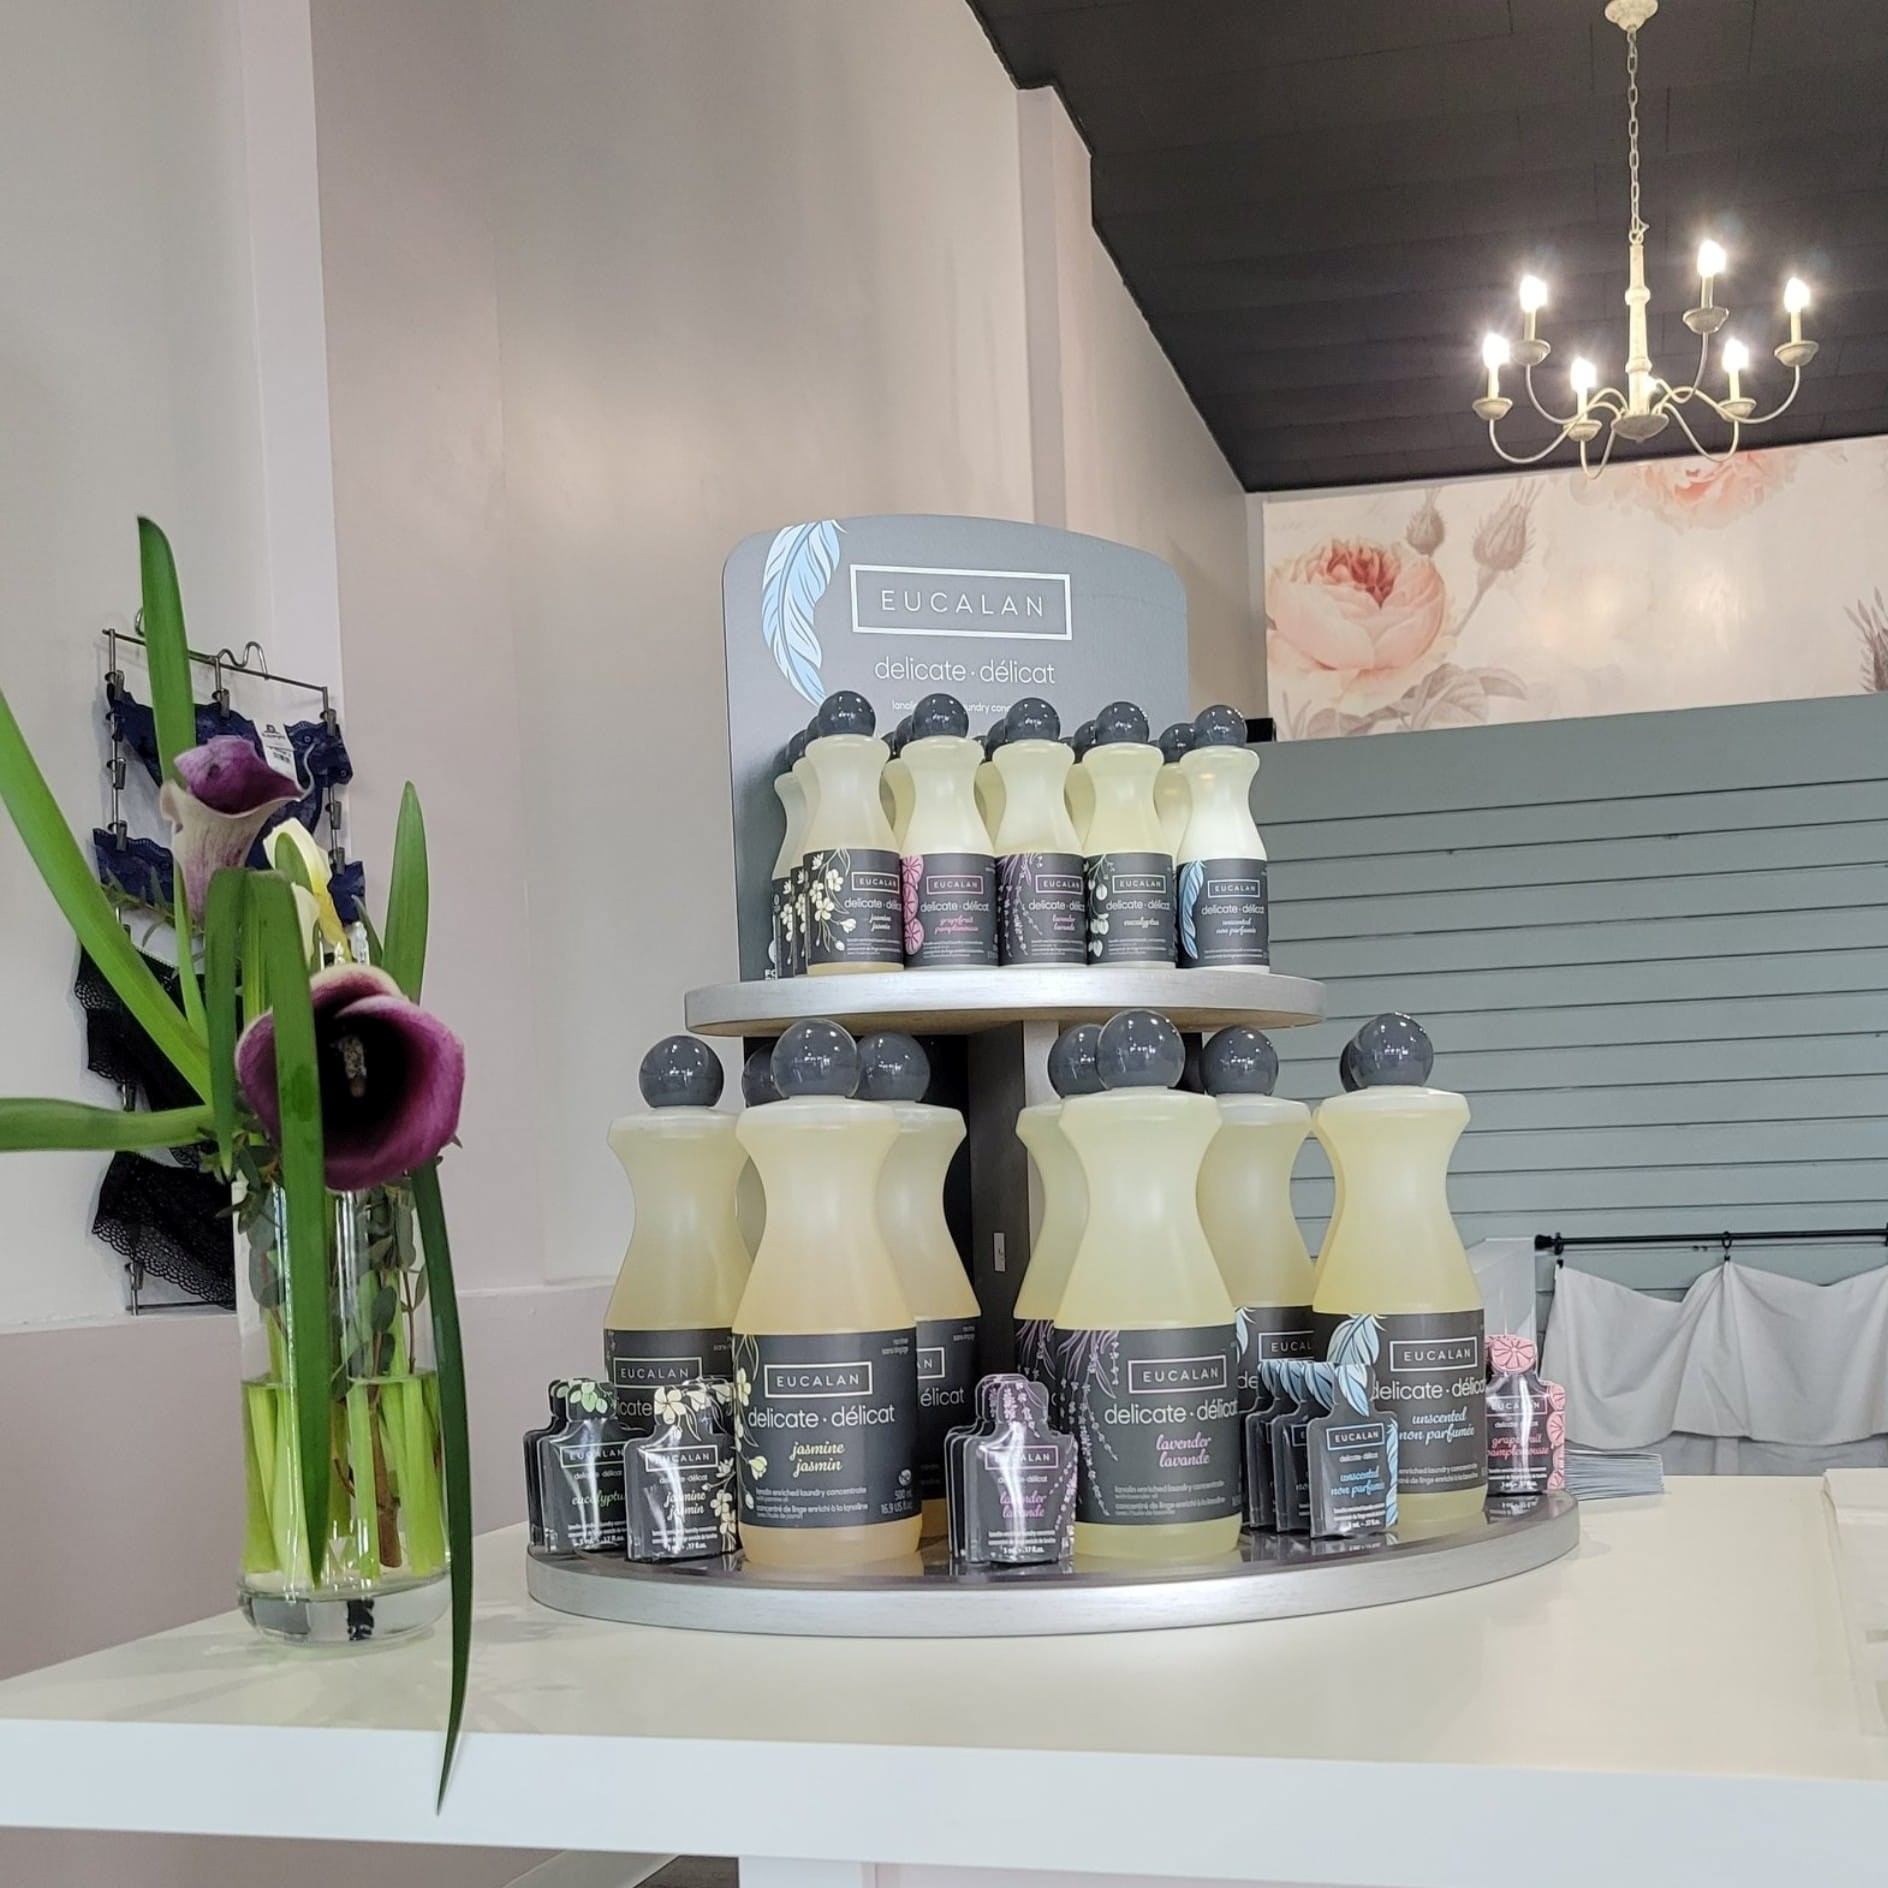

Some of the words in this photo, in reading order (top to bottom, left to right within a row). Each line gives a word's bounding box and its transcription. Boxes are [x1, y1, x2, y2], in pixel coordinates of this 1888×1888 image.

[881, 589, 1043, 617] EUCALAN
[874, 656, 966, 681] delicate
[979, 659, 1056, 685] délicat
[965, 702, 989, 714] undry
[933, 880, 978, 889] EUCALAN
[1119, 880, 1161, 888] EUCALAN
[1214, 884, 1256, 892] EUCALAN
[844, 897, 882, 909] delicate
[920, 900, 958, 913] delicate
[1028, 899, 1066, 910] delicate
[1105, 900, 1144, 911] delicate
[1201, 903, 1238, 915] delicate
[1271, 1341, 1312, 1353] EUCAL
[1403, 1348, 1471, 1362] EUCALAN
[620, 1367, 689, 1379] EUCALAN
[1143, 1367, 1219, 1383] EUCALAN
[776, 1374, 859, 1388] EUCALAN
[920, 1388, 965, 1408] élicat
[1491, 1402, 1540, 1411] UCAN
[748, 1407, 819, 1429] delicate
[831, 1404, 895, 1428] délicat
[1104, 1403, 1187, 1425] delicate
[1412, 1406, 1468, 1426] unscented
[1156, 1432, 1212, 1451] lavender
[1334, 1431, 1380, 1444] EUCALAN
[1398, 1430, 1424, 1441] non
[1425, 1423, 1475, 1446] parfumée
[789, 1441, 846, 1461] jasmine
[1159, 1449, 1211, 1468] lavande
[792, 1458, 843, 1478] jasmin
[664, 1489, 706, 1508] jamine
[1000, 1490, 1047, 1505] lander
[667, 1502, 705, 1521] jamin
[1003, 1504, 1045, 1518] lande
